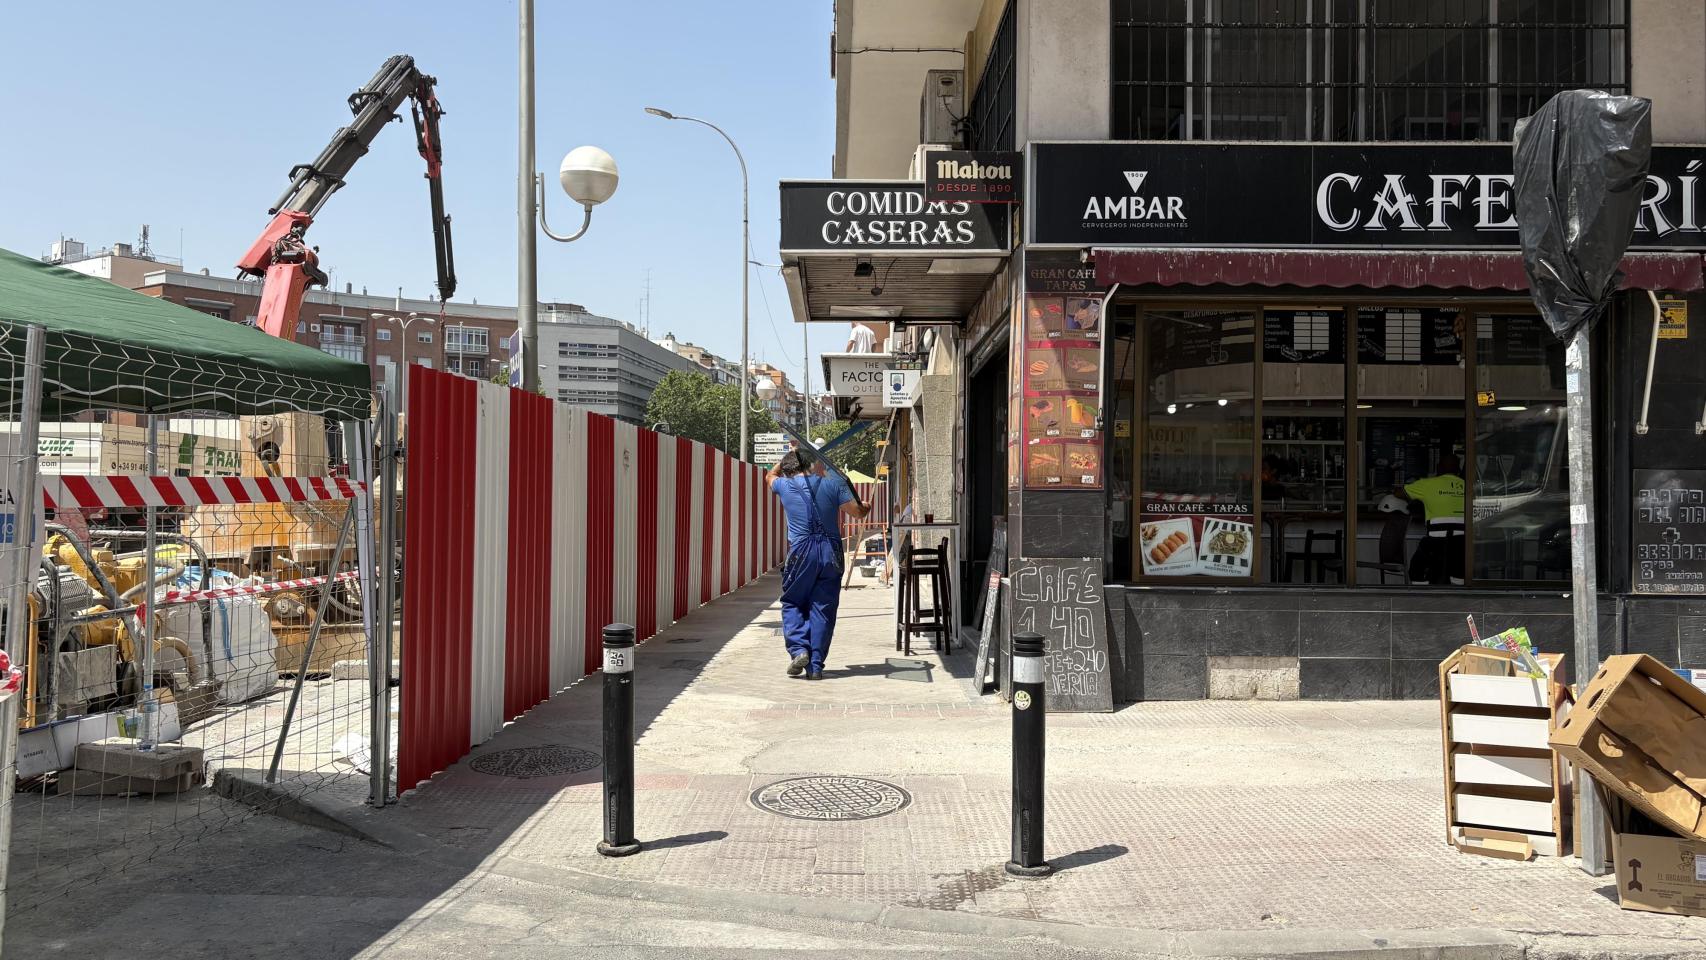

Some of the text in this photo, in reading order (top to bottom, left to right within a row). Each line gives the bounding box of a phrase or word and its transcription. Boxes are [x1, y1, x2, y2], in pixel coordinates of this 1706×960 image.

[937, 160, 1012, 179] Mahou
[937, 183, 1011, 192] DESDE 1890
[1083, 196, 1187, 220] AMBAR
[822, 220, 975, 245] CASERAS
[1031, 269, 1065, 279] GRAN
[1045, 281, 1086, 290] TAPAS
[842, 372, 883, 383] FACTO
[205, 446, 241, 468] TRAN
[1639, 489, 1704, 504] PLATO
[1147, 504, 1175, 512] GRAN
[1213, 504, 1248, 513] TAPAS
[1639, 507, 1672, 523] DEL
[1638, 544, 1706, 560] BEBIDA
